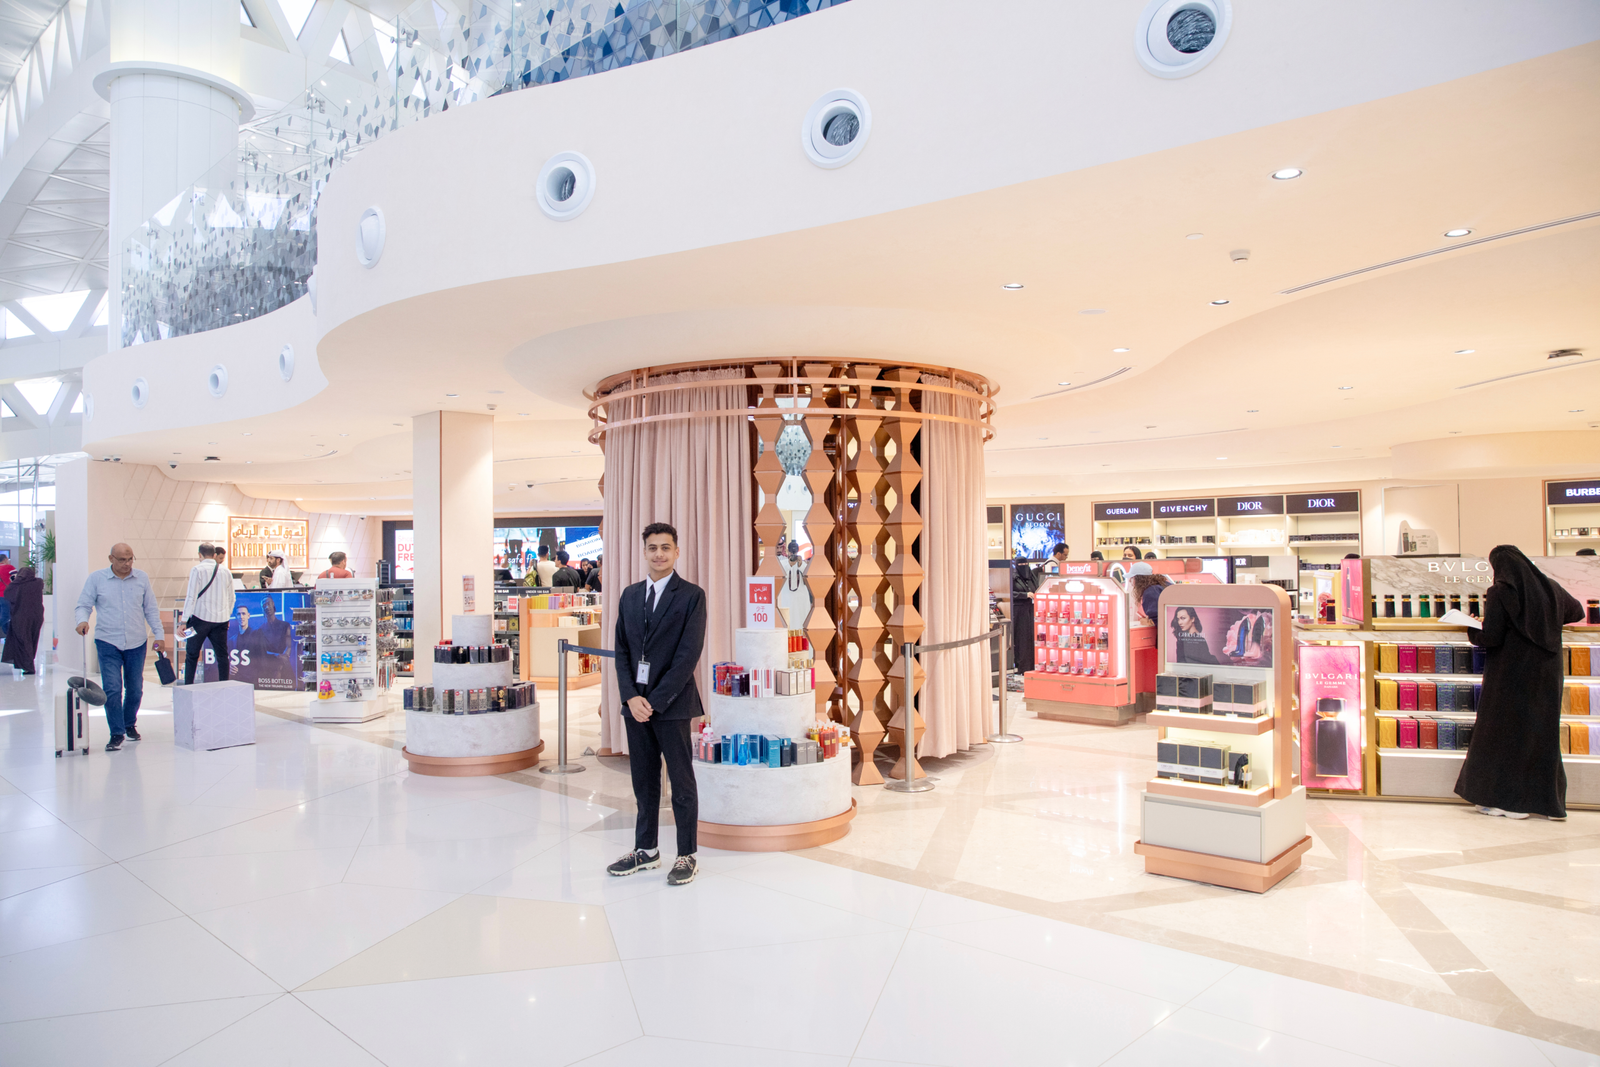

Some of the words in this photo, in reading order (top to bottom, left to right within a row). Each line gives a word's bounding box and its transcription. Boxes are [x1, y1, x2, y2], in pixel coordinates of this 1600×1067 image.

[1237, 502, 1262, 511] DIOR
[1307, 498, 1335, 508] DIOR
[1106, 507, 1139, 515] GUERLAIN
[1160, 504, 1207, 513] GIVENCHY
[1015, 512, 1060, 521] GUCCI
[232, 543, 264, 557] RIYADH
[288, 543, 306, 557] FREE
[397, 543, 414, 552] DU
[507, 553, 523, 564] safe
[1066, 563, 1092, 574] benefit
[753, 612, 768, 622] 100
[205, 648, 251, 666] BSS
